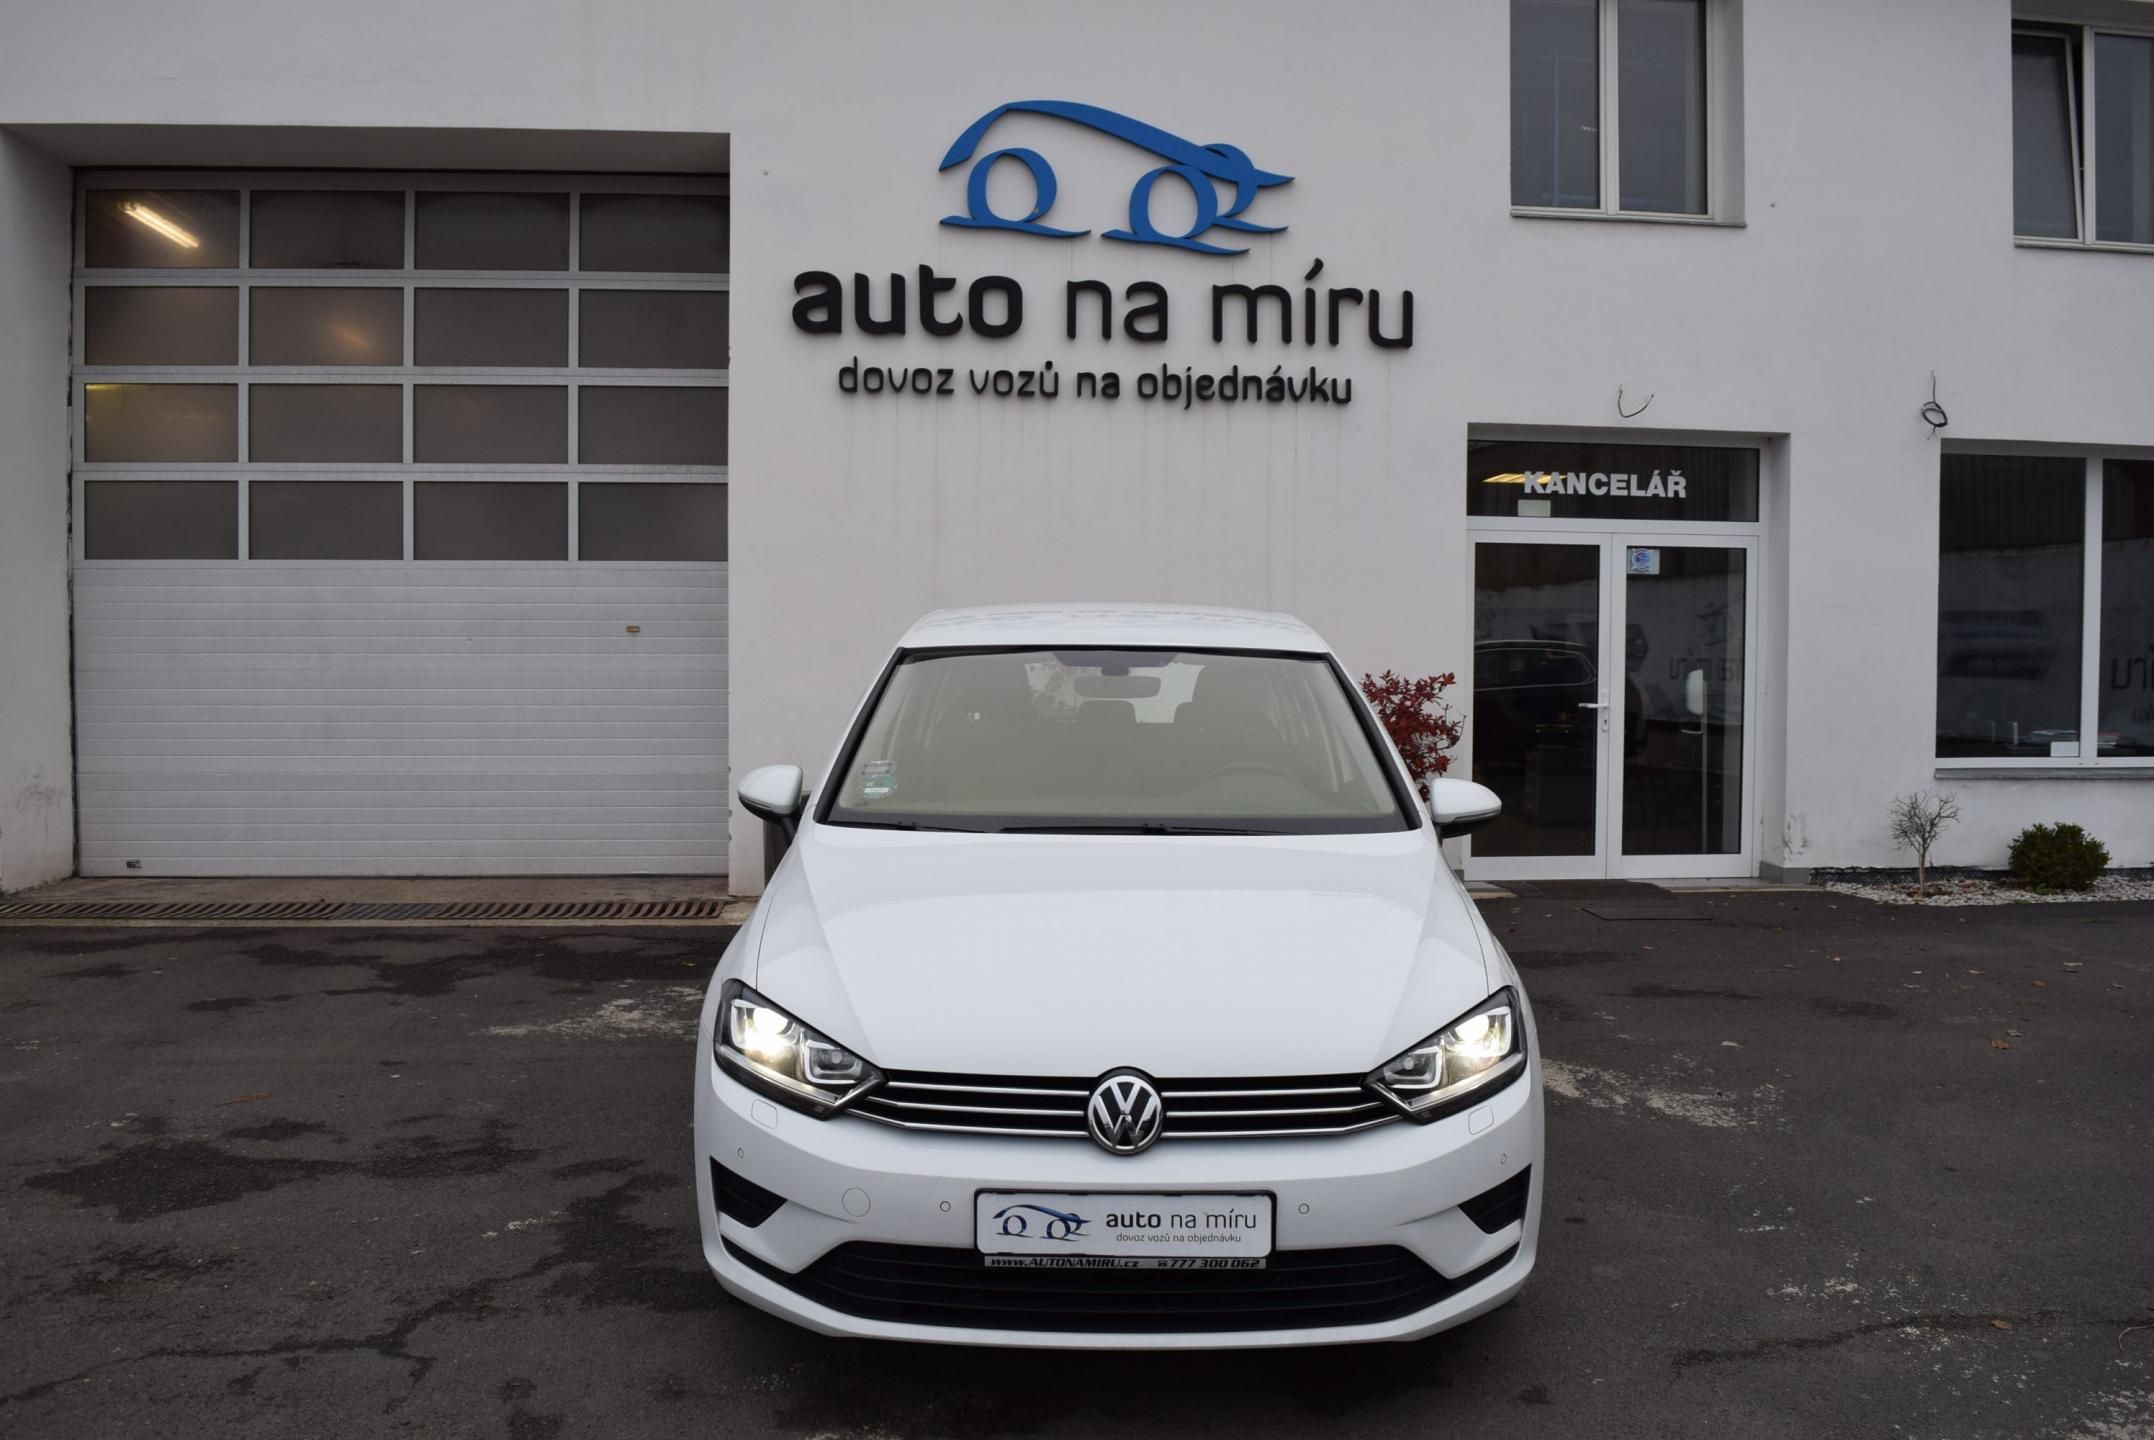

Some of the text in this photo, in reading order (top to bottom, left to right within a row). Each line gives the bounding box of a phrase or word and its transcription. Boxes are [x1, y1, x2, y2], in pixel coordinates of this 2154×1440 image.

[792, 258, 1414, 353] auto na míru
[838, 356, 1352, 411] dovoz vozů na objednávku
[1523, 470, 1687, 498] KANCELÁŘ
[1106, 1208, 1257, 1229] auto na míru
[1116, 1232, 1145, 1242] dovoz
[1148, 1232, 1170, 1242] vozů
[1187, 1232, 1241, 1244] objednávku
[990, 1257, 1260, 1269] www.AUTONAMIRU.cz 777 300 062
